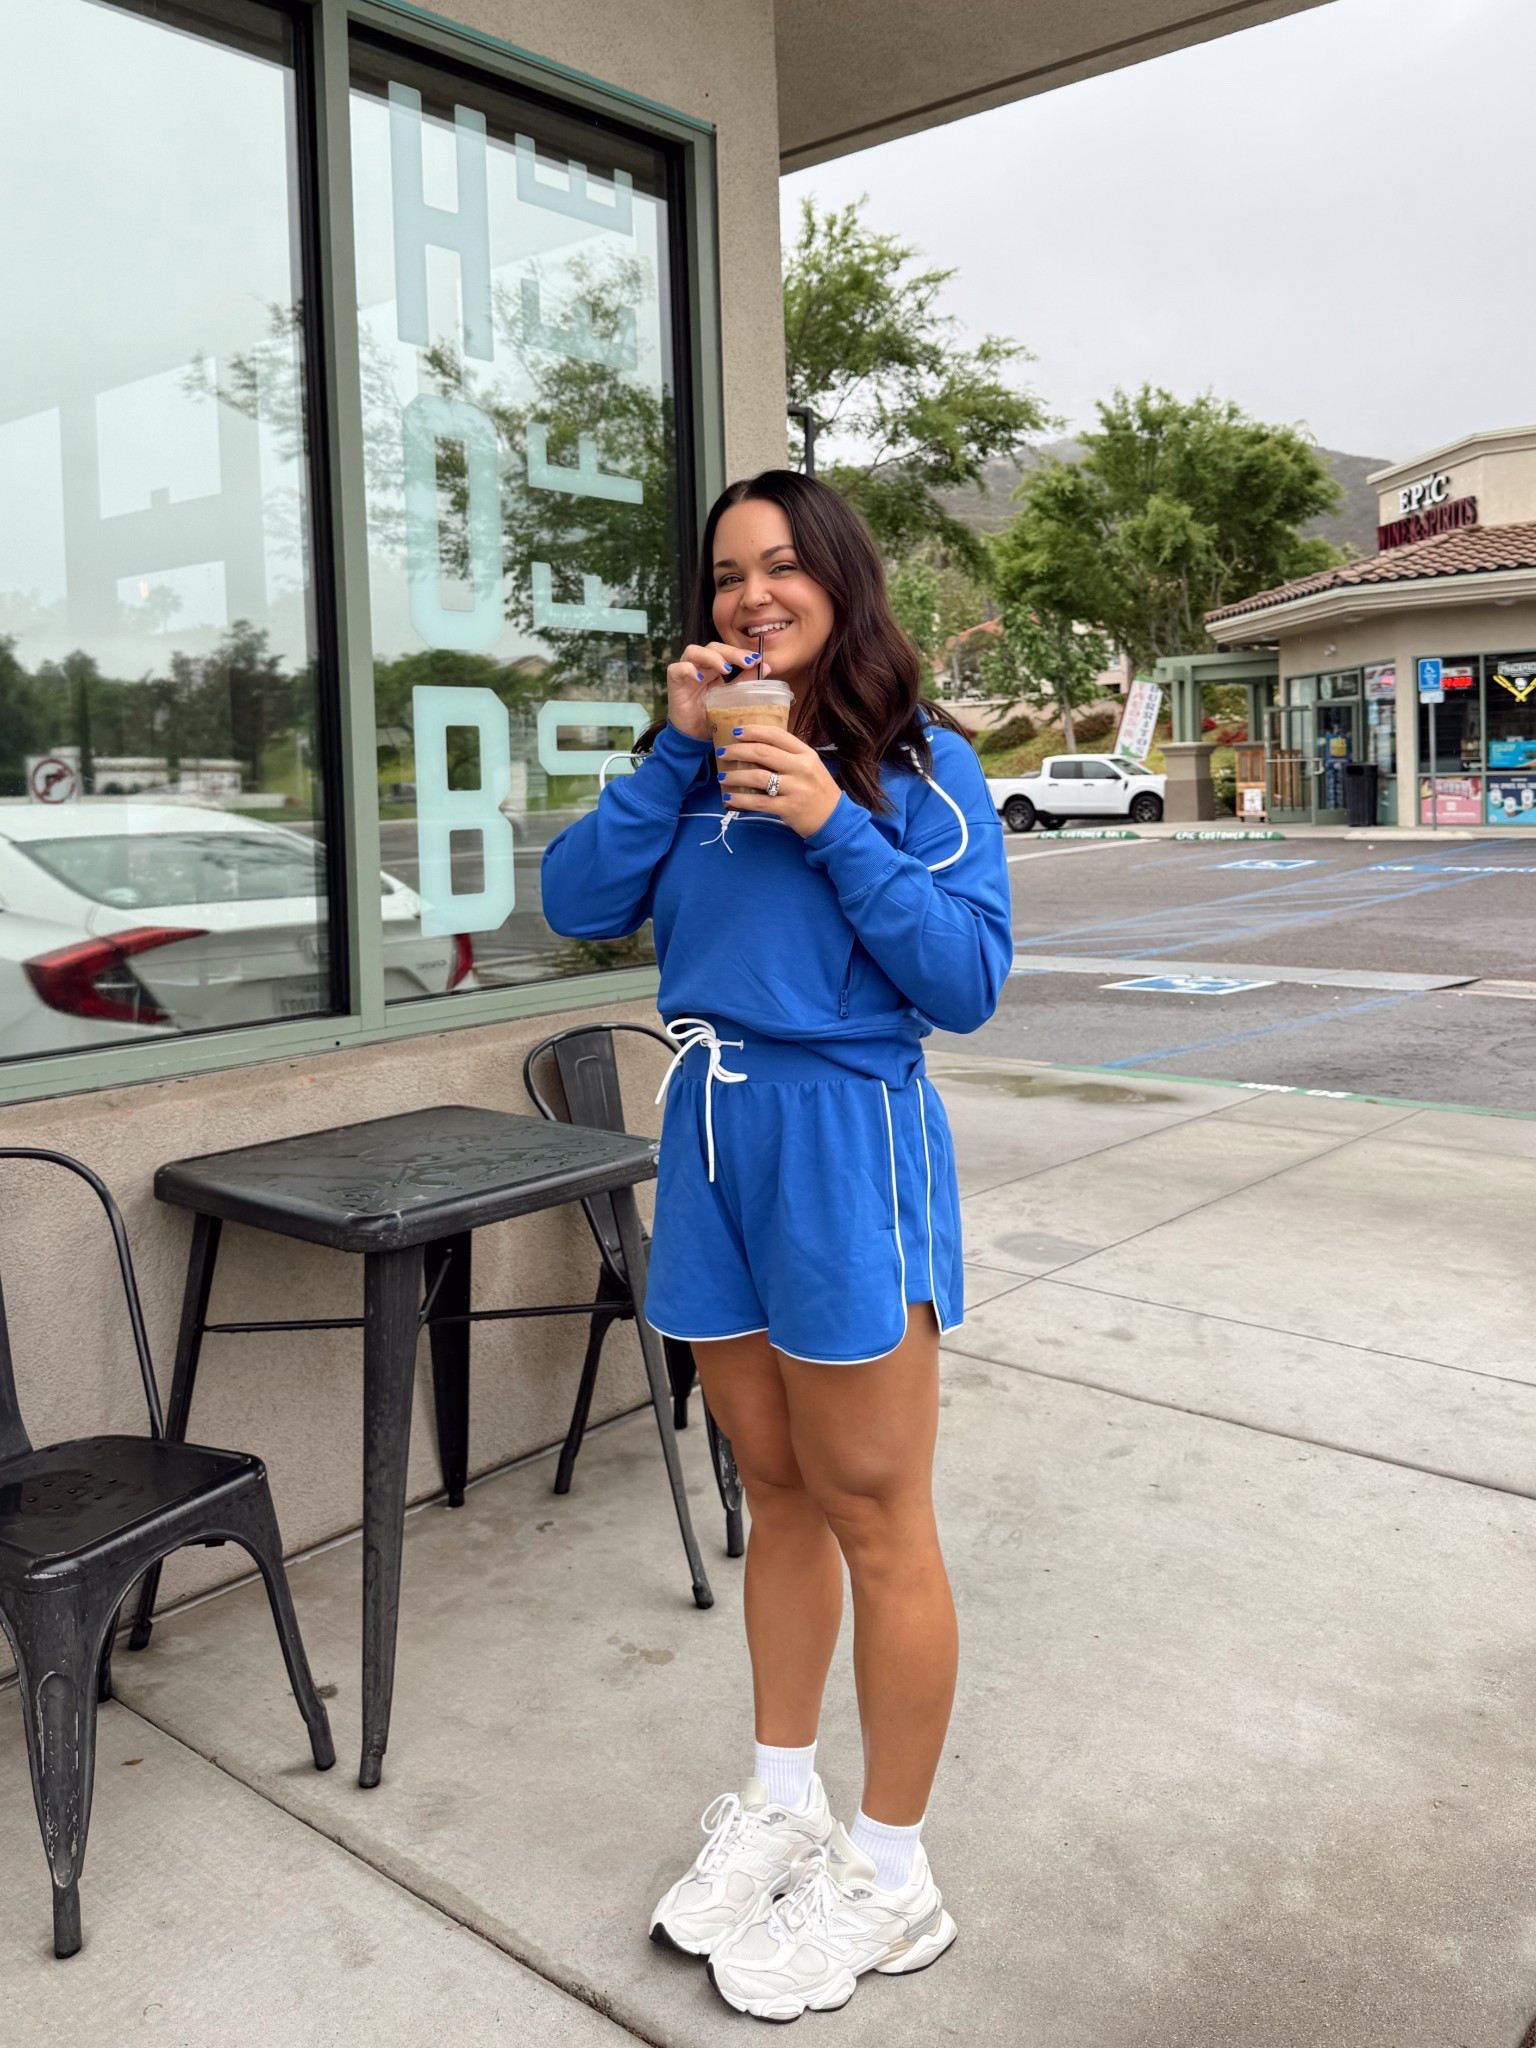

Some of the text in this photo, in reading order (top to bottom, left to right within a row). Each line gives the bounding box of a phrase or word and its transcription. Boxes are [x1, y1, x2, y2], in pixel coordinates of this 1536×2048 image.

[515, 130, 652, 776] OFFEE
[1398, 473, 1449, 514] EPIC
[1423, 496, 1478, 537] SPIRITS
